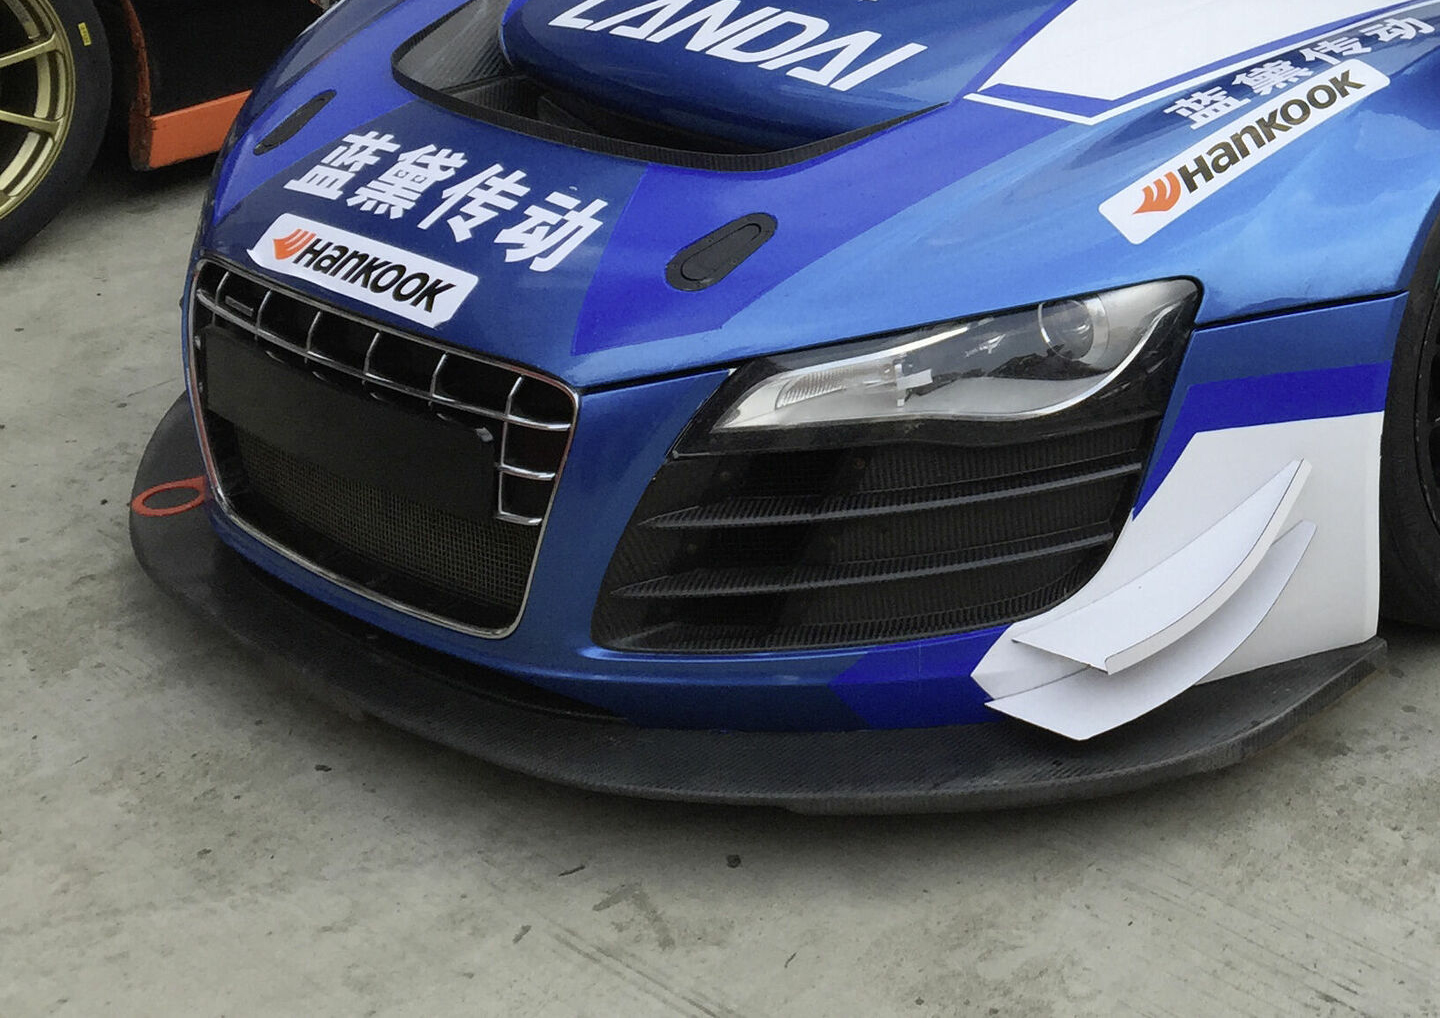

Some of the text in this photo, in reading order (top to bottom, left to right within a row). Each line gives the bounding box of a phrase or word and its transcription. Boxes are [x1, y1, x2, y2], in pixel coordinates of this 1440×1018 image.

[1164, 17, 1435, 130] 蓝黛传动
[283, 131, 609, 272] 蓝黛传动
